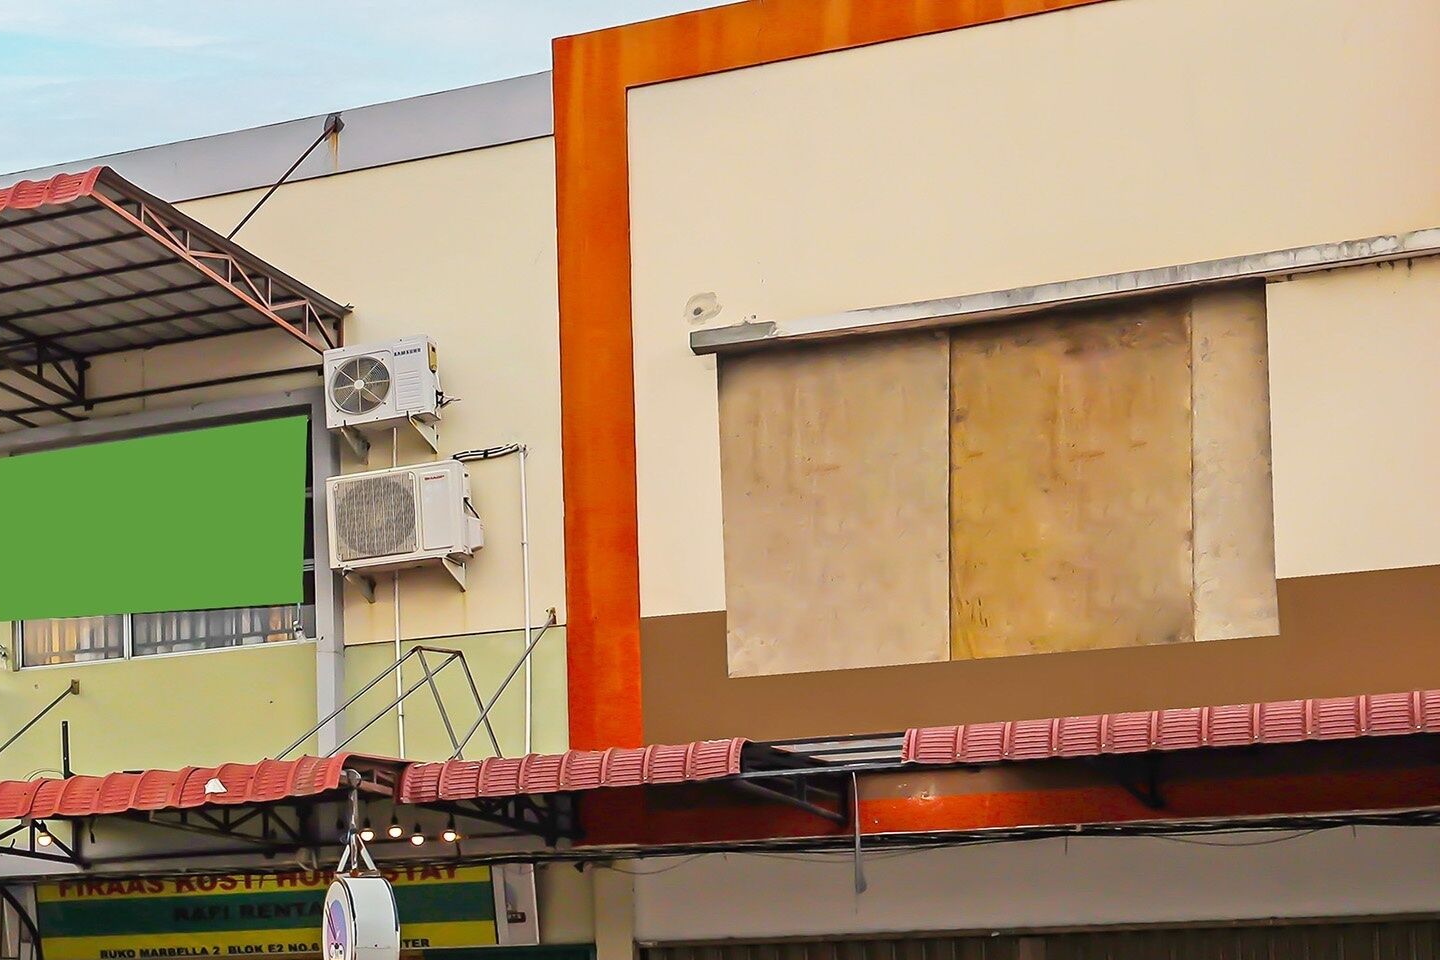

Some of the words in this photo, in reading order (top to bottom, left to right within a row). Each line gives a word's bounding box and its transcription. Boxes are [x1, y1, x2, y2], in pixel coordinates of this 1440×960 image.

[100, 949, 136, 959] RUKO
[140, 946, 210, 957] MARBELLA
[213, 946, 221, 955] 2
[227, 945, 264, 954] BLOK
[268, 944, 284, 953] E2
